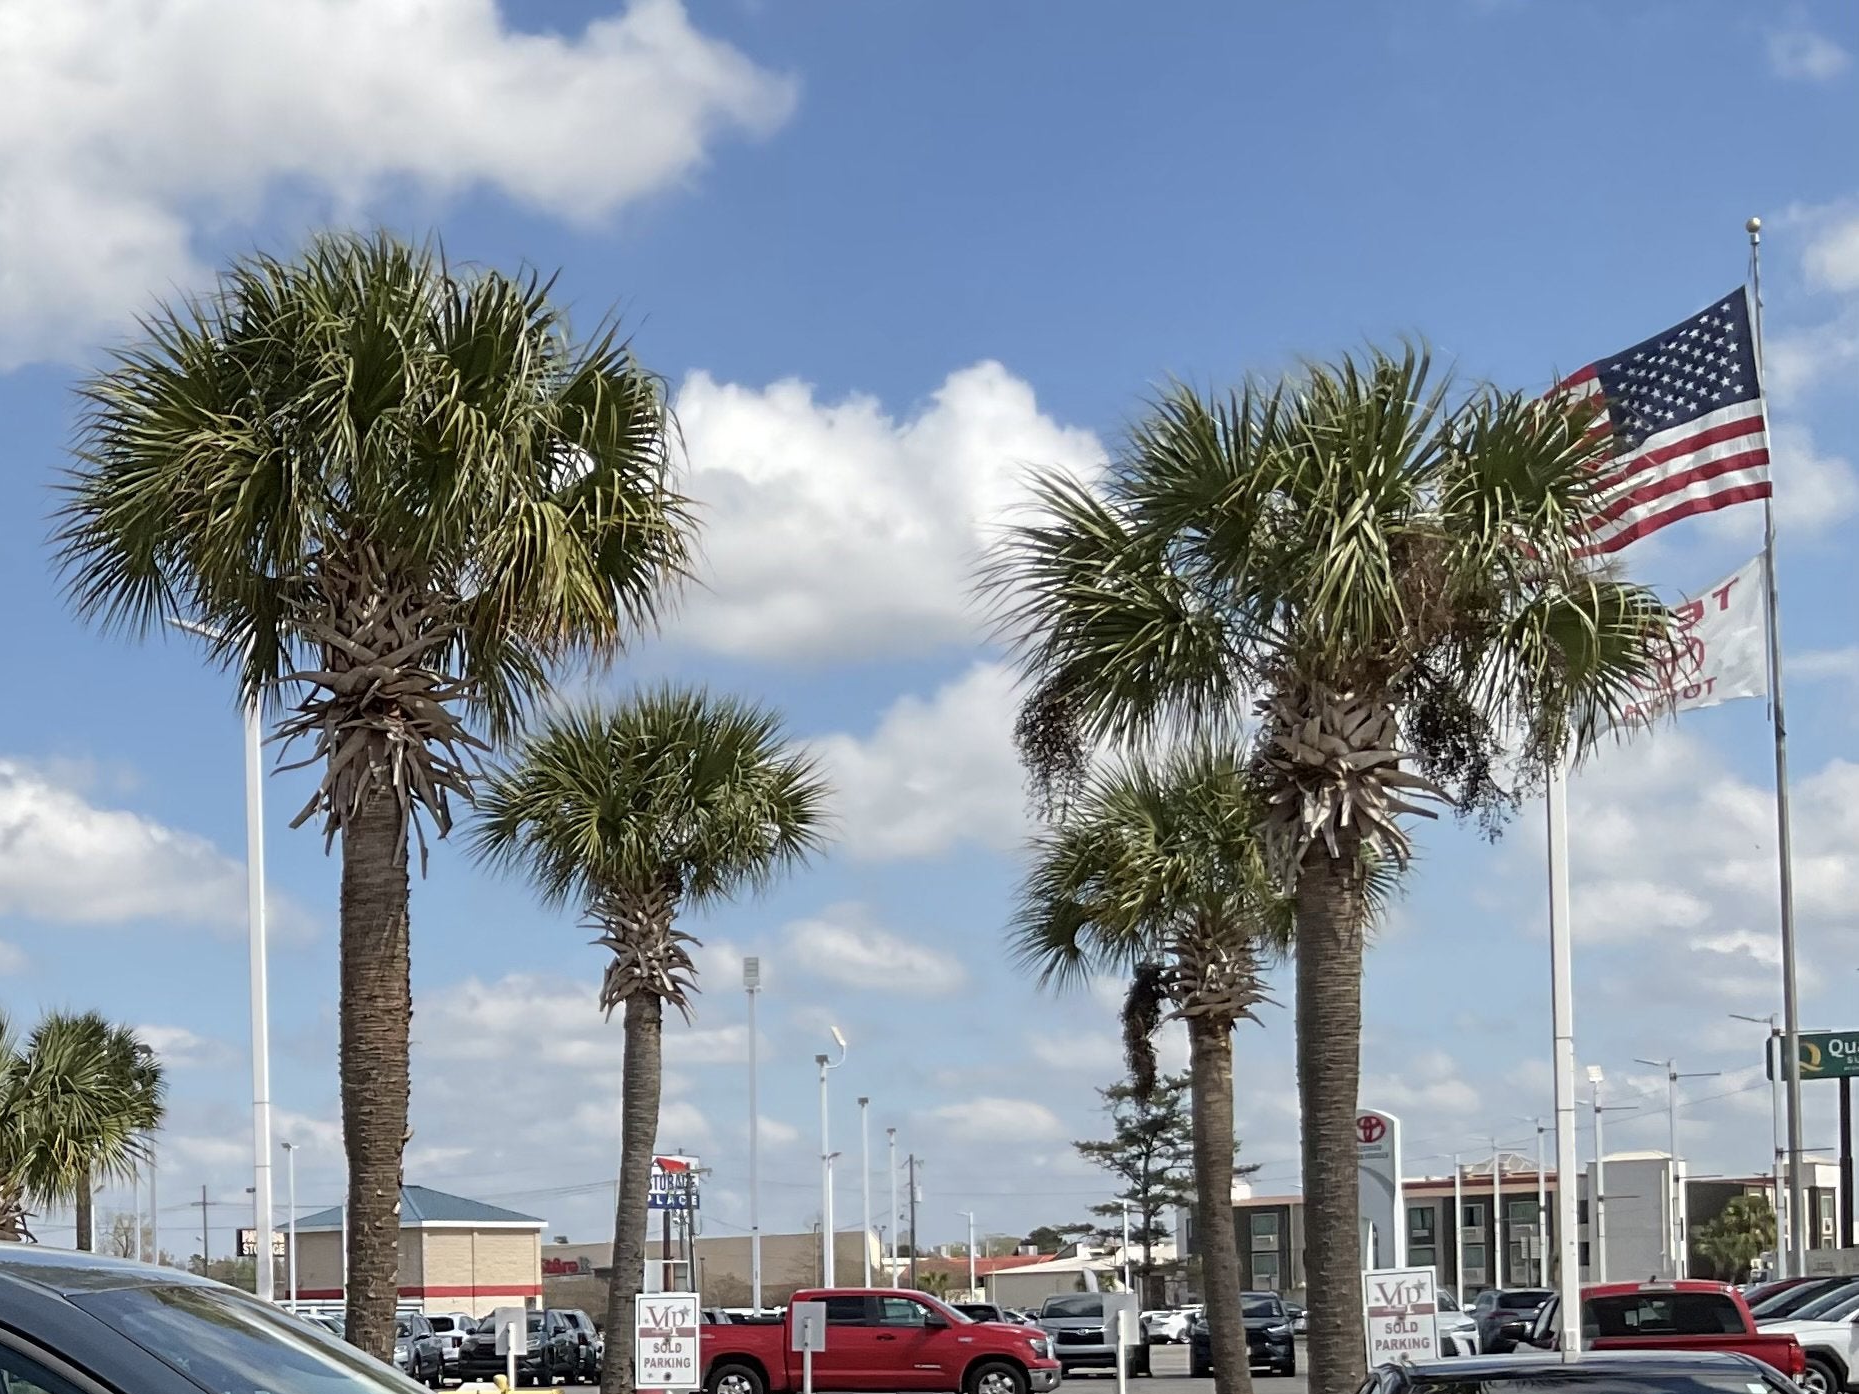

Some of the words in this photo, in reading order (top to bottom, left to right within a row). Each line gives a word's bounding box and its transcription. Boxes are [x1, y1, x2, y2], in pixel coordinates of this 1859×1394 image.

[1828, 1038, 1859, 1058] Qu
[242, 1243, 286, 1255] STGE
[1384, 1321, 1419, 1335] SOLD
[652, 1342, 682, 1353] SOLD
[1374, 1337, 1431, 1351] PARKING
[643, 1357, 691, 1368] PARKING
